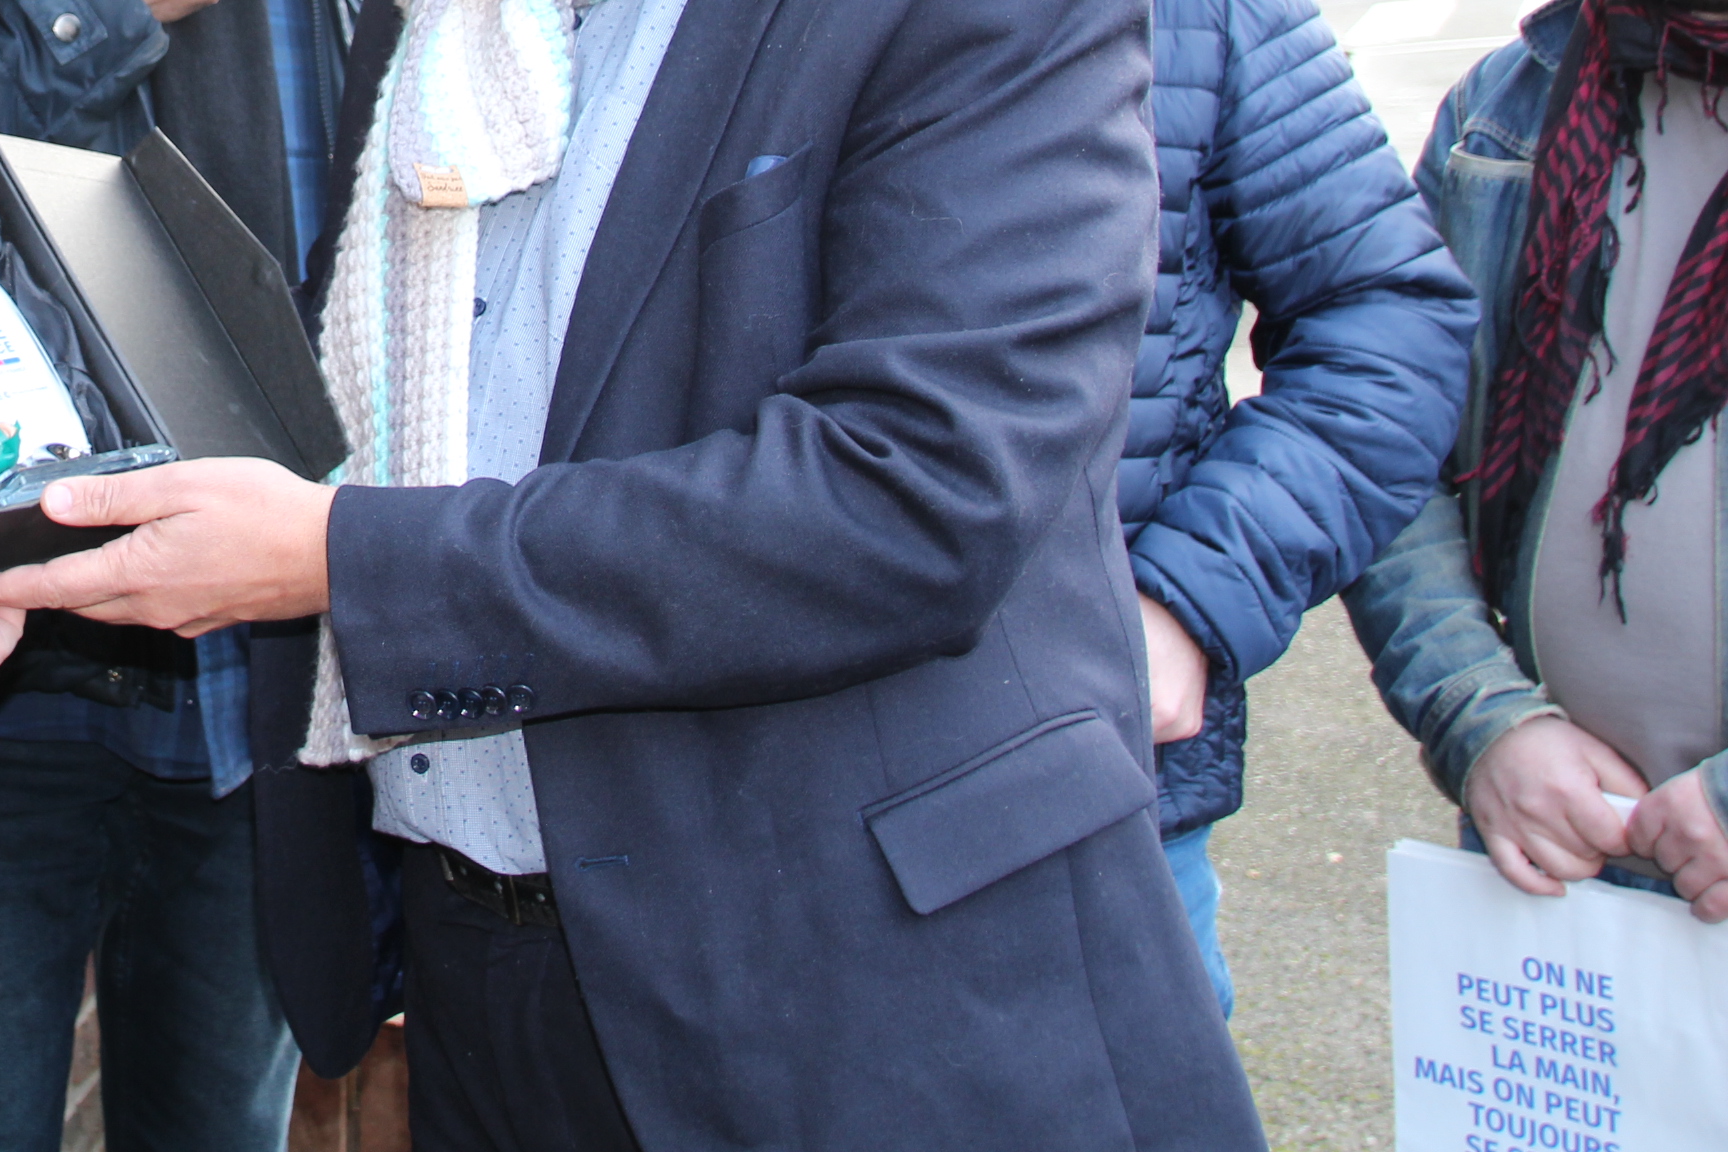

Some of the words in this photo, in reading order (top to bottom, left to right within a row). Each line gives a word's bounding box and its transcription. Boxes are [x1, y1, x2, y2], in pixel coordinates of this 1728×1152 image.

[1457, 972, 1530, 1010] PEUT
[1539, 992, 1615, 1033] PLUS
[1522, 956, 1565, 988] ON
[1575, 968, 1614, 1000] NE
[1460, 1005, 1494, 1035] SE
[1502, 1015, 1618, 1068] SERRER
[1414, 1056, 1485, 1094] MAIS
[1493, 1077, 1535, 1109] ON
[1545, 1090, 1621, 1133] PEUT
[1491, 1044, 1527, 1075] LA
[1535, 1056, 1620, 1105] MAIN,
